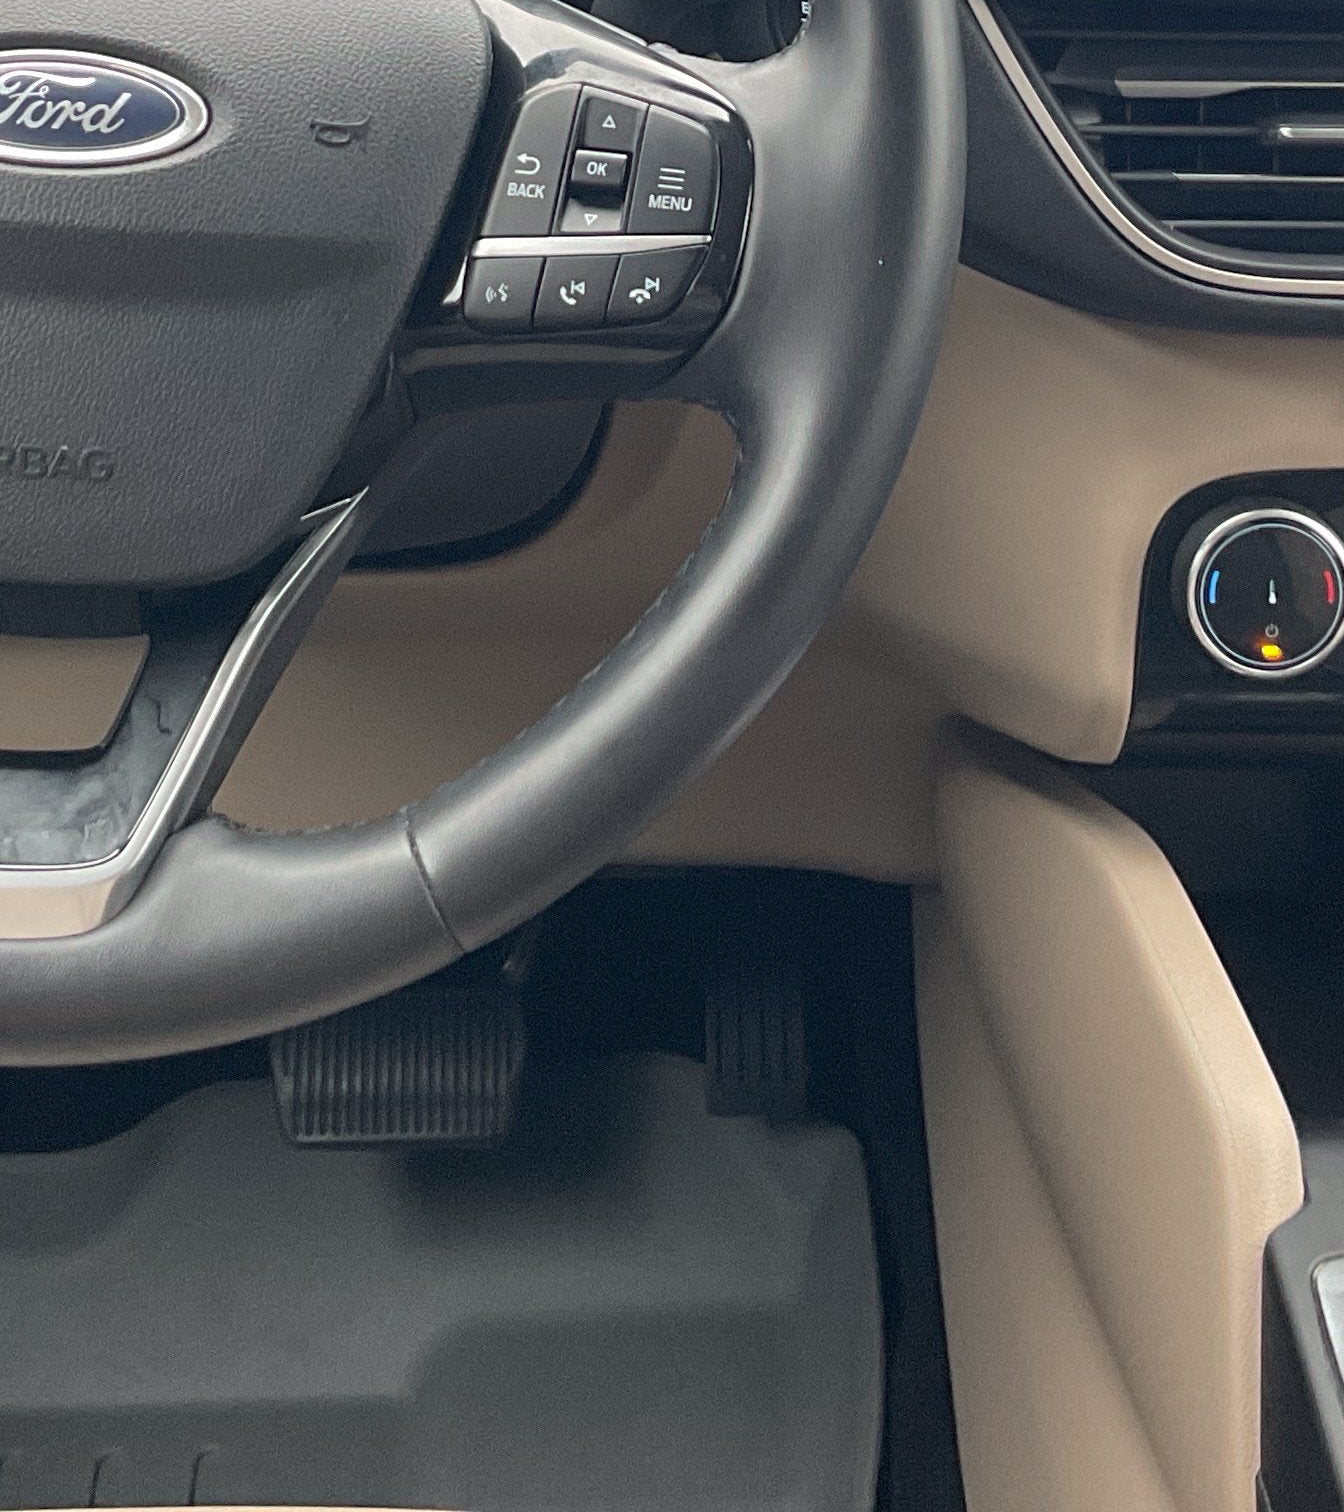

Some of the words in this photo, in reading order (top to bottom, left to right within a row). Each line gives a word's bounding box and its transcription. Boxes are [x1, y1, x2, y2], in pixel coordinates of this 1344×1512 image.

[586, 161, 608, 176] OK
[506, 182, 546, 199] BACK
[648, 194, 693, 212] MENU
